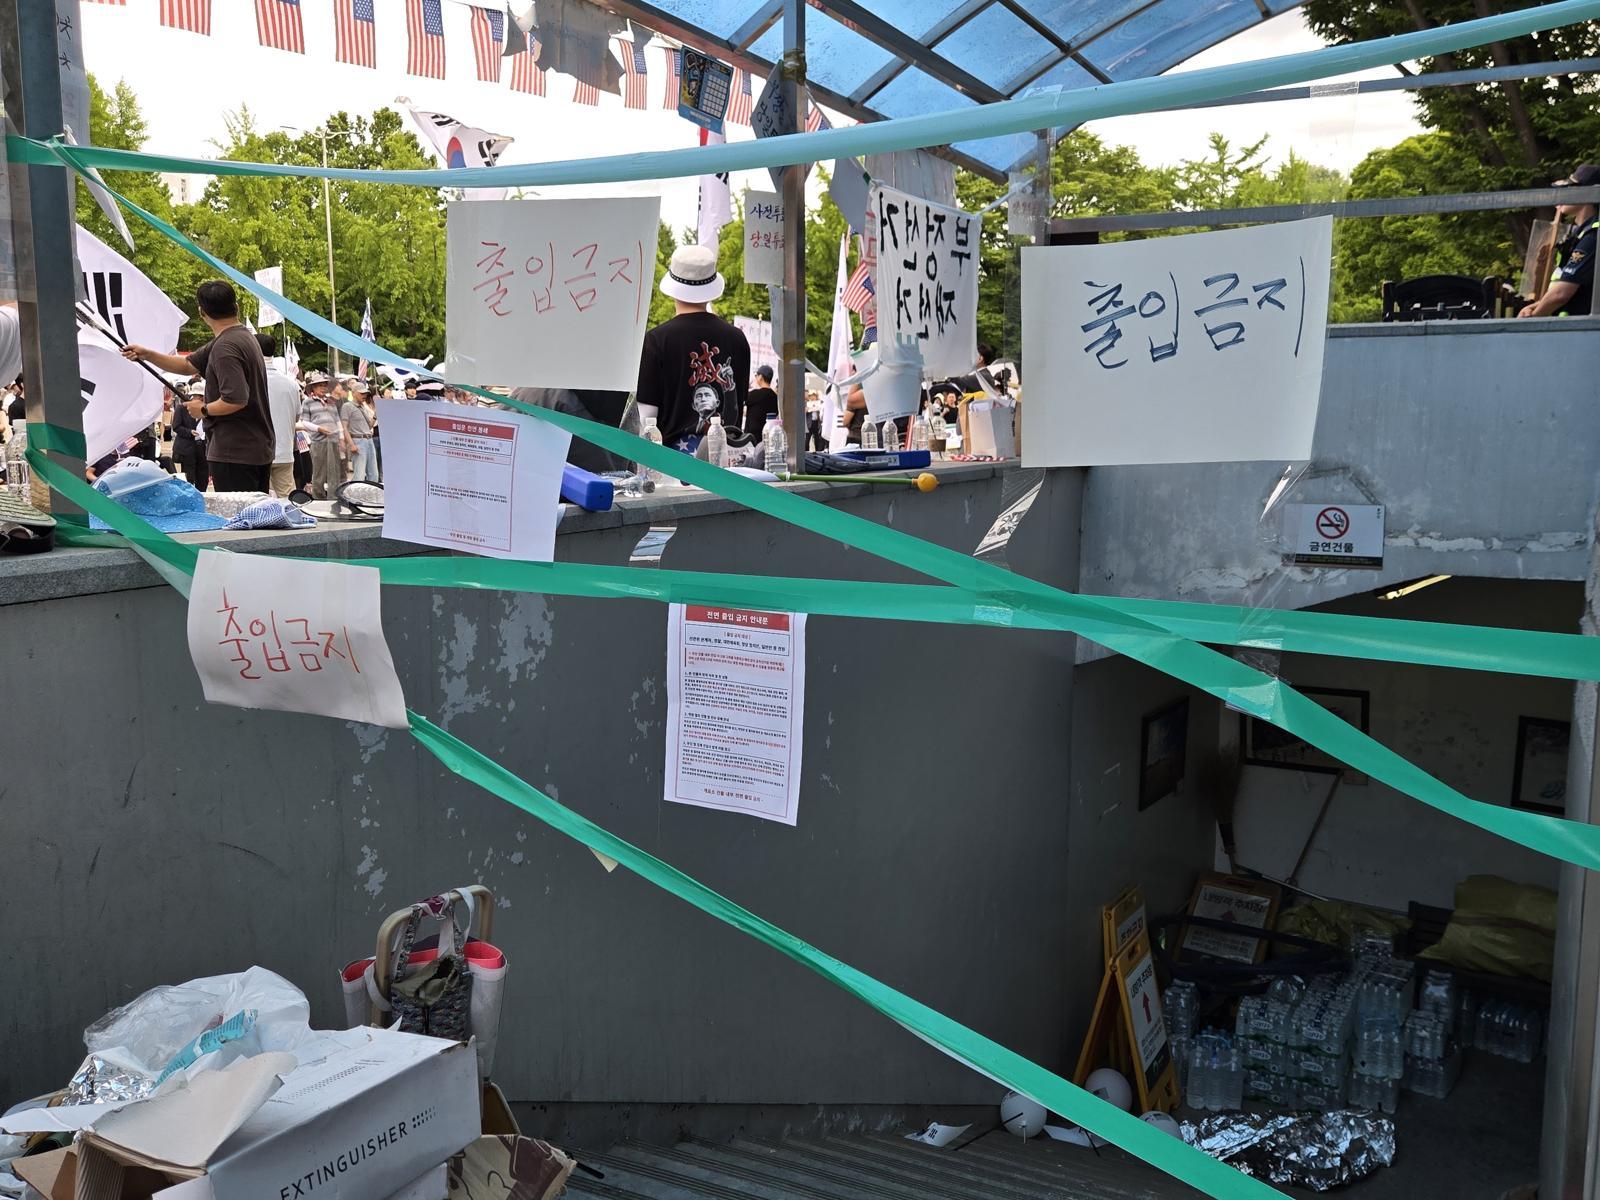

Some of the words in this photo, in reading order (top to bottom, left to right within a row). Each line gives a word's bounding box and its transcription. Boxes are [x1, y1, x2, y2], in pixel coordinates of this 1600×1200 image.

[473, 240, 643, 325] 출입금지
[1309, 541, 1354, 553] 금연건물
[216, 586, 361, 680] 출입금지
[706, 611, 720, 621] 전면
[721, 612, 734, 622] 출입
[735, 613, 748, 623] 금지
[750, 615, 769, 625] 안내문
[280, 1121, 408, 1200] EXTINGUISHER
